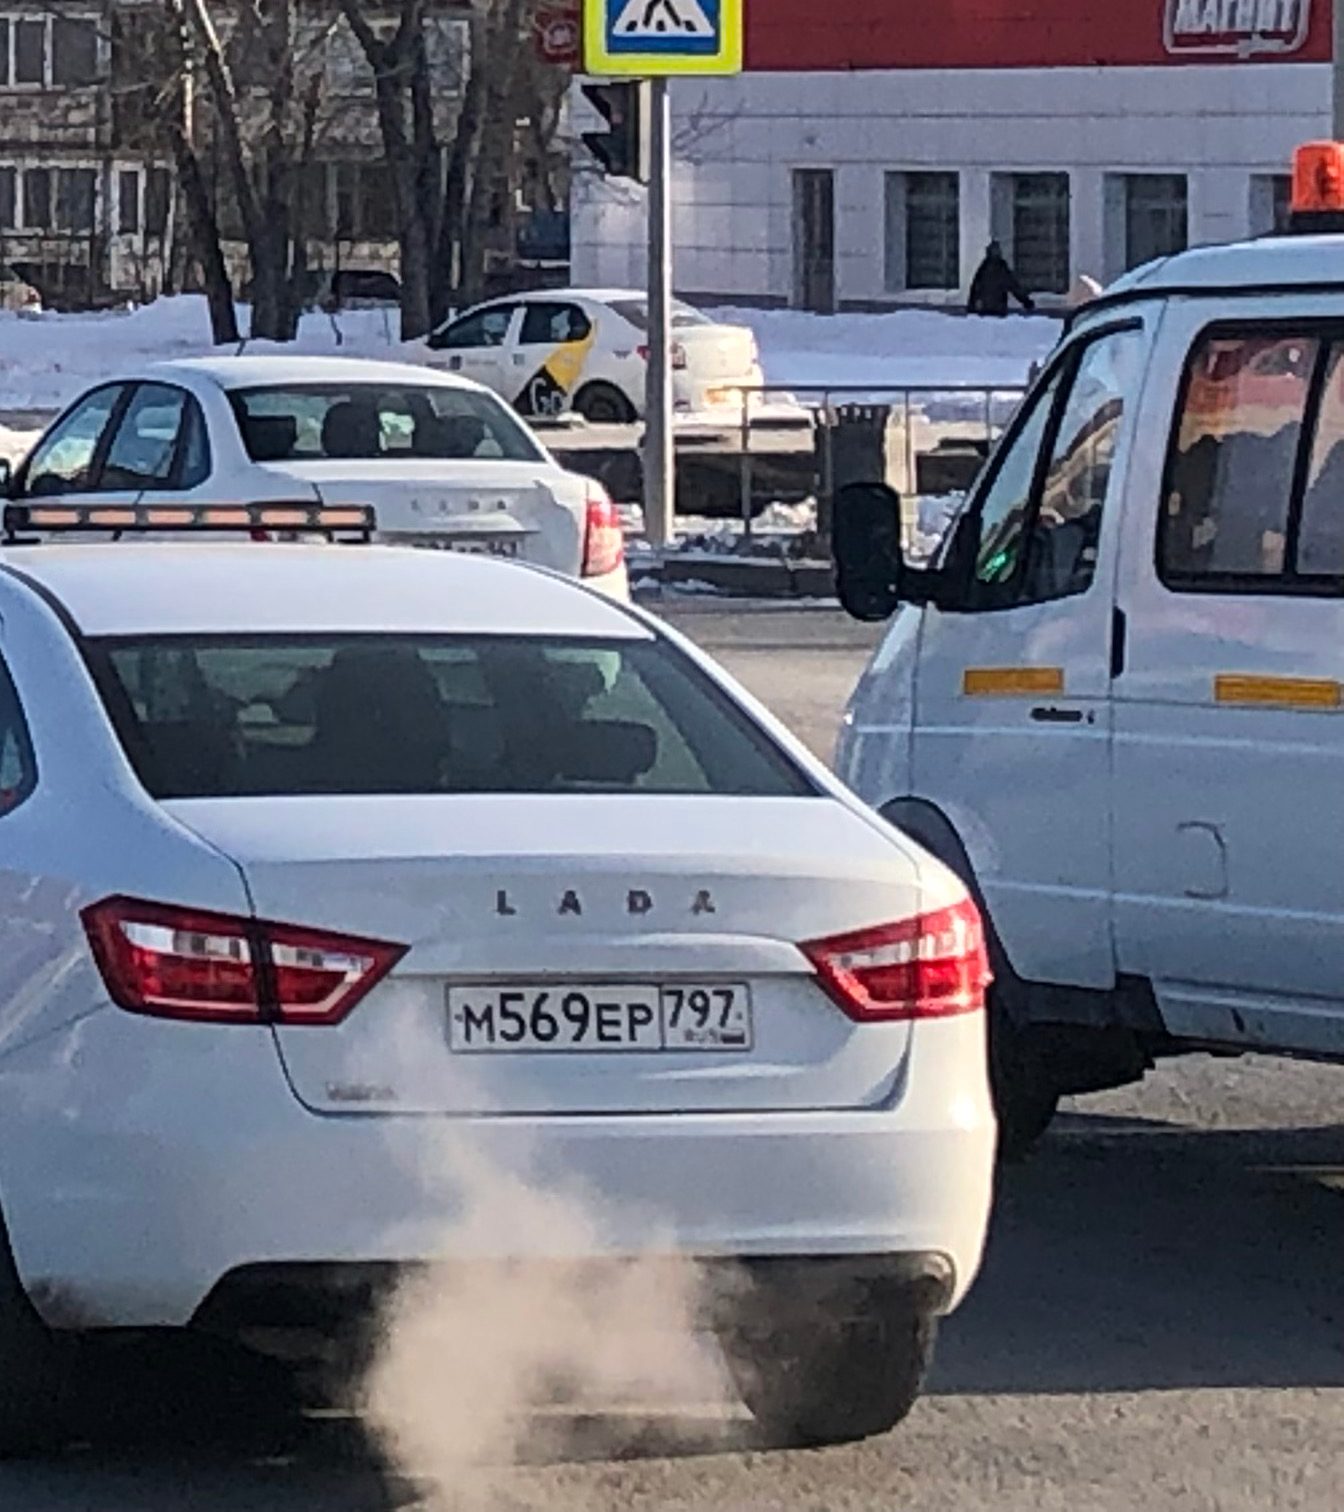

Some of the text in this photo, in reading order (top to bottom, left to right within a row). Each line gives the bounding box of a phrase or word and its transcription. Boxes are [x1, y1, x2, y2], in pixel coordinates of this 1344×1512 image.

[496, 890, 715, 916] LADA
[463, 989, 734, 1044] М569ЕР 797
